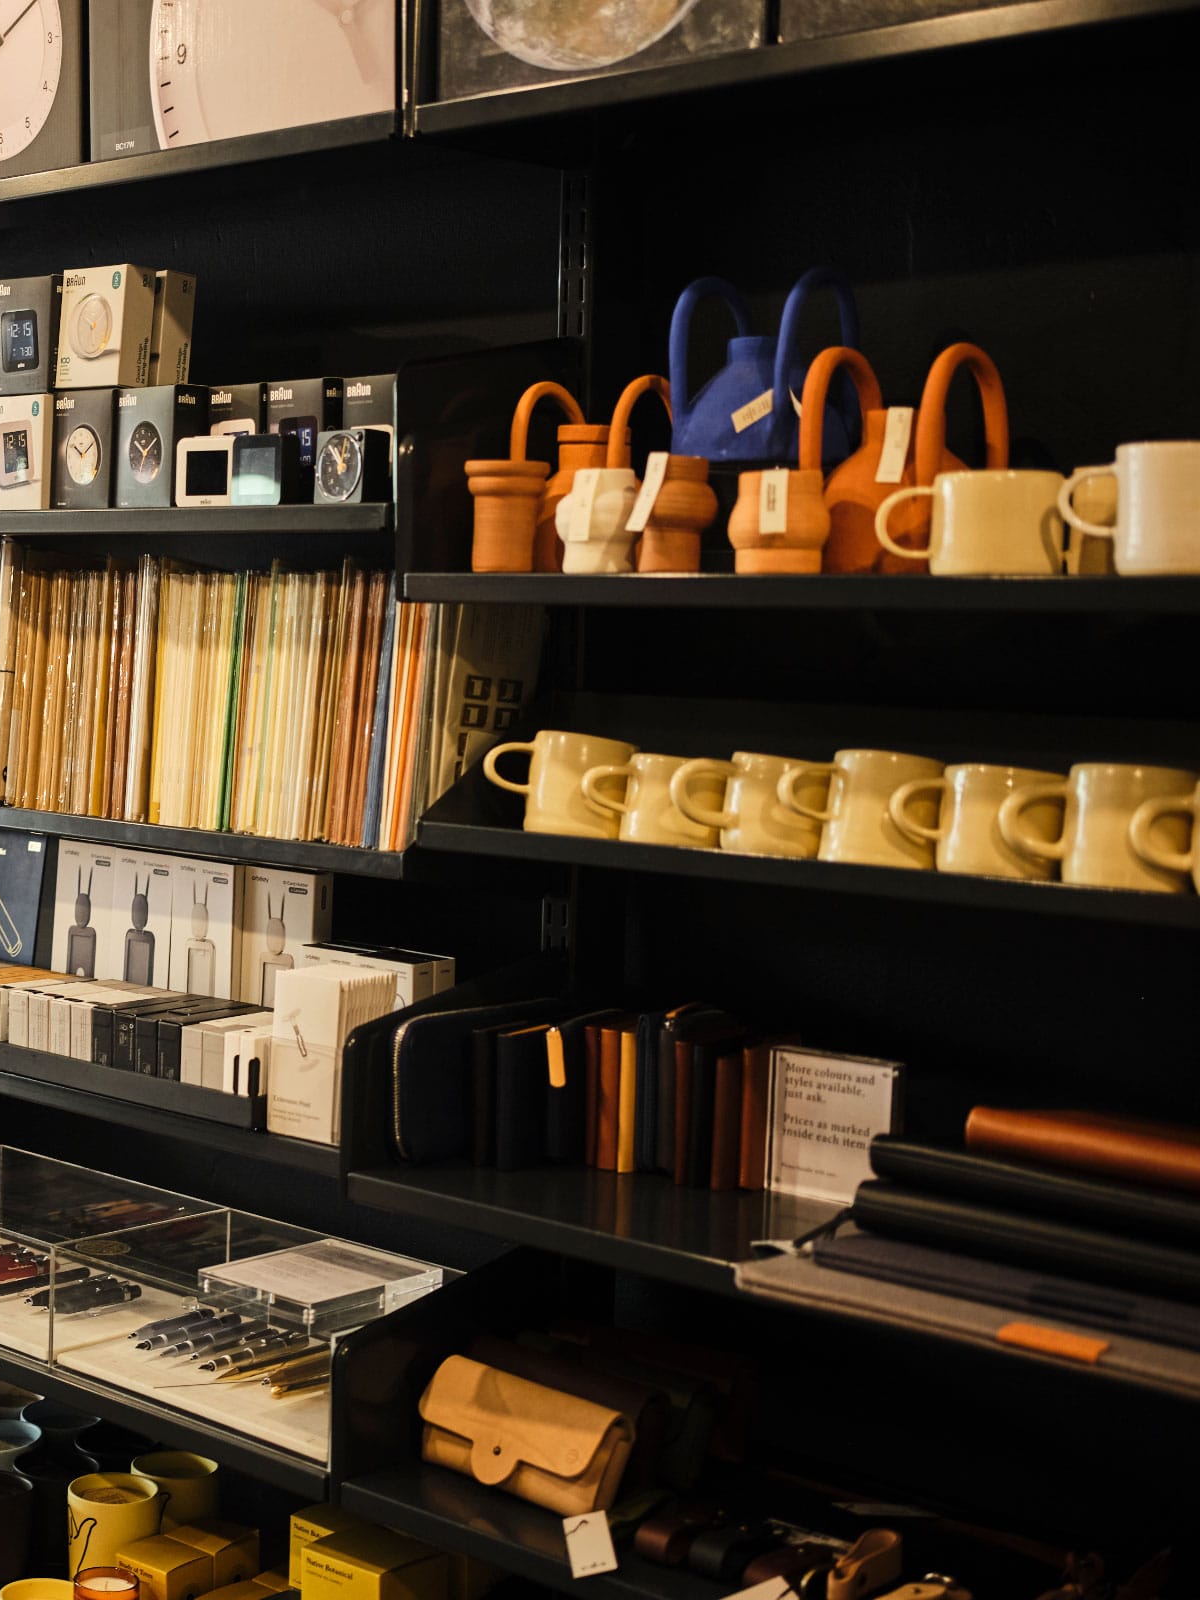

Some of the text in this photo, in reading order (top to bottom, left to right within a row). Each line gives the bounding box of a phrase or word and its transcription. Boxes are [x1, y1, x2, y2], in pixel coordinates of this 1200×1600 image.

[47, 31, 53, 44] 3
[176, 42, 188, 66] 9
[42, 80, 49, 92] 4
[24, 117, 31, 129] 5
[66, 275, 86, 287] BRAUN
[270, 387, 293, 401] BRAUN
[346, 382, 371, 398] BRAUN
[56, 397, 75, 410] BRAUN
[118, 394, 137, 407] BRAUN
[178, 394, 196, 405] BRAUN
[211, 390, 232, 405] BRAUN
[786, 1063, 875, 1086] More colours and
[785, 1077, 814, 1089] styles
[784, 1089, 803, 1101] just
[784, 1113, 870, 1137] Prices as marked
[783, 1128, 813, 1140] inside
[816, 1134, 839, 1145] each
[306, 1556, 325, 1572] Native
[324, 1564, 354, 1582] Botanical
